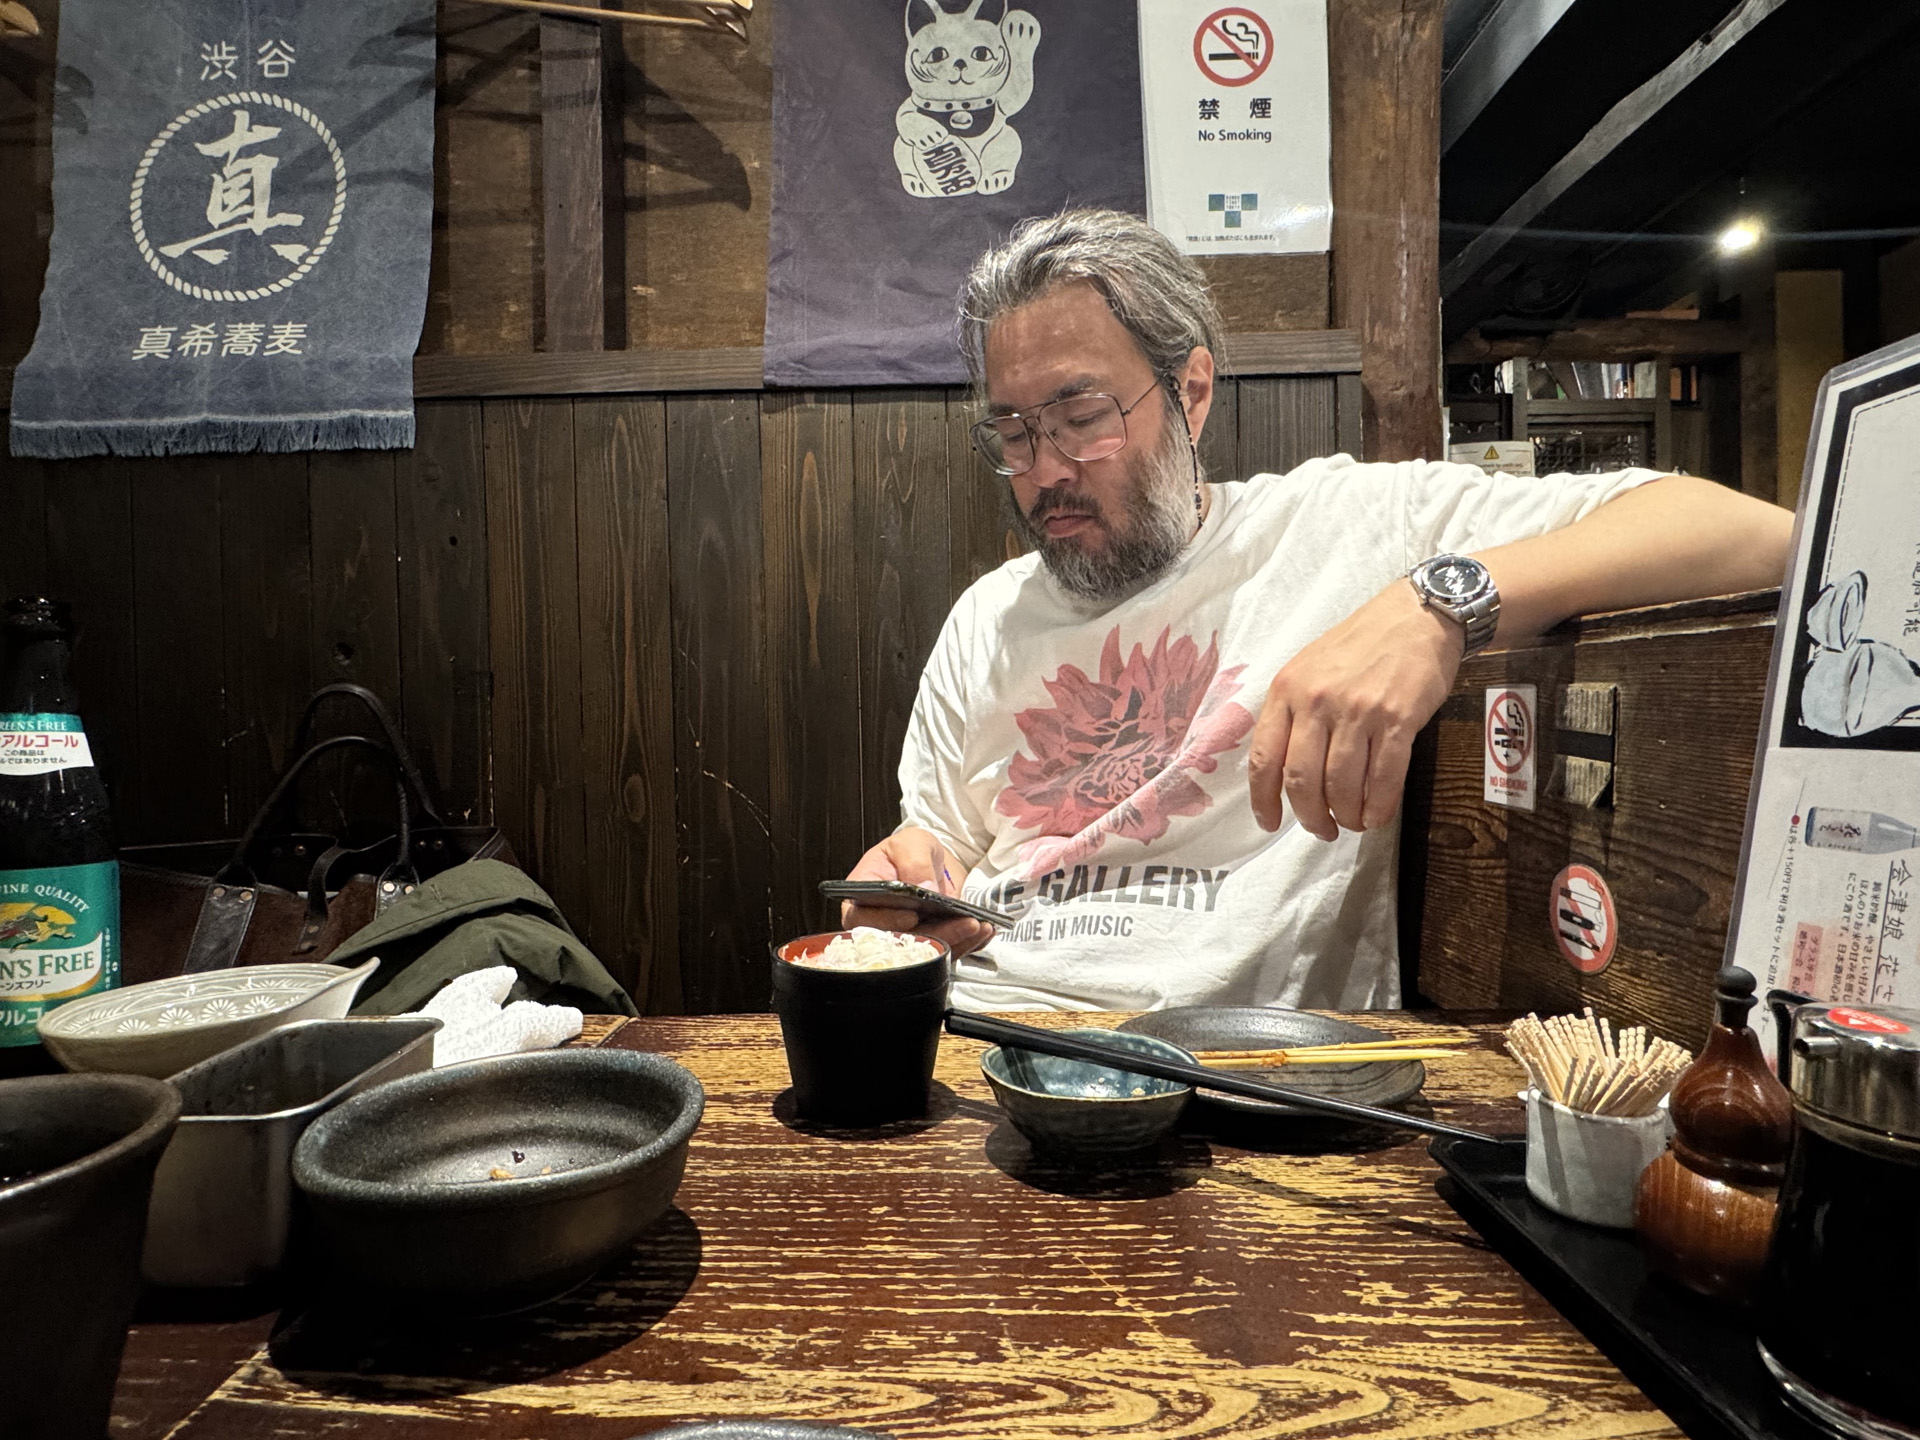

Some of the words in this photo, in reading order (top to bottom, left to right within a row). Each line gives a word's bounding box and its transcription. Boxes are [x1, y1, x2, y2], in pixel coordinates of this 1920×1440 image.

[200, 40, 297, 81] 渋谷
[1198, 129, 1215, 141] No
[1218, 128, 1272, 143] Smoking
[159, 110, 310, 265] 真
[131, 321, 308, 361] 真希蕎麦
[37, 720, 68, 731] FREE
[0, 734, 79, 748] アルコール
[1499, 777, 1528, 791] SMOKING
[0, 883, 29, 895] INE
[34, 884, 91, 913] QUALITY
[1037, 864, 1230, 912] GALLERY
[1884, 858, 1913, 940] 会津娘
[1049, 918, 1067, 941] IN
[1070, 915, 1134, 938] MUSIC
[38, 951, 95, 978] FREE
